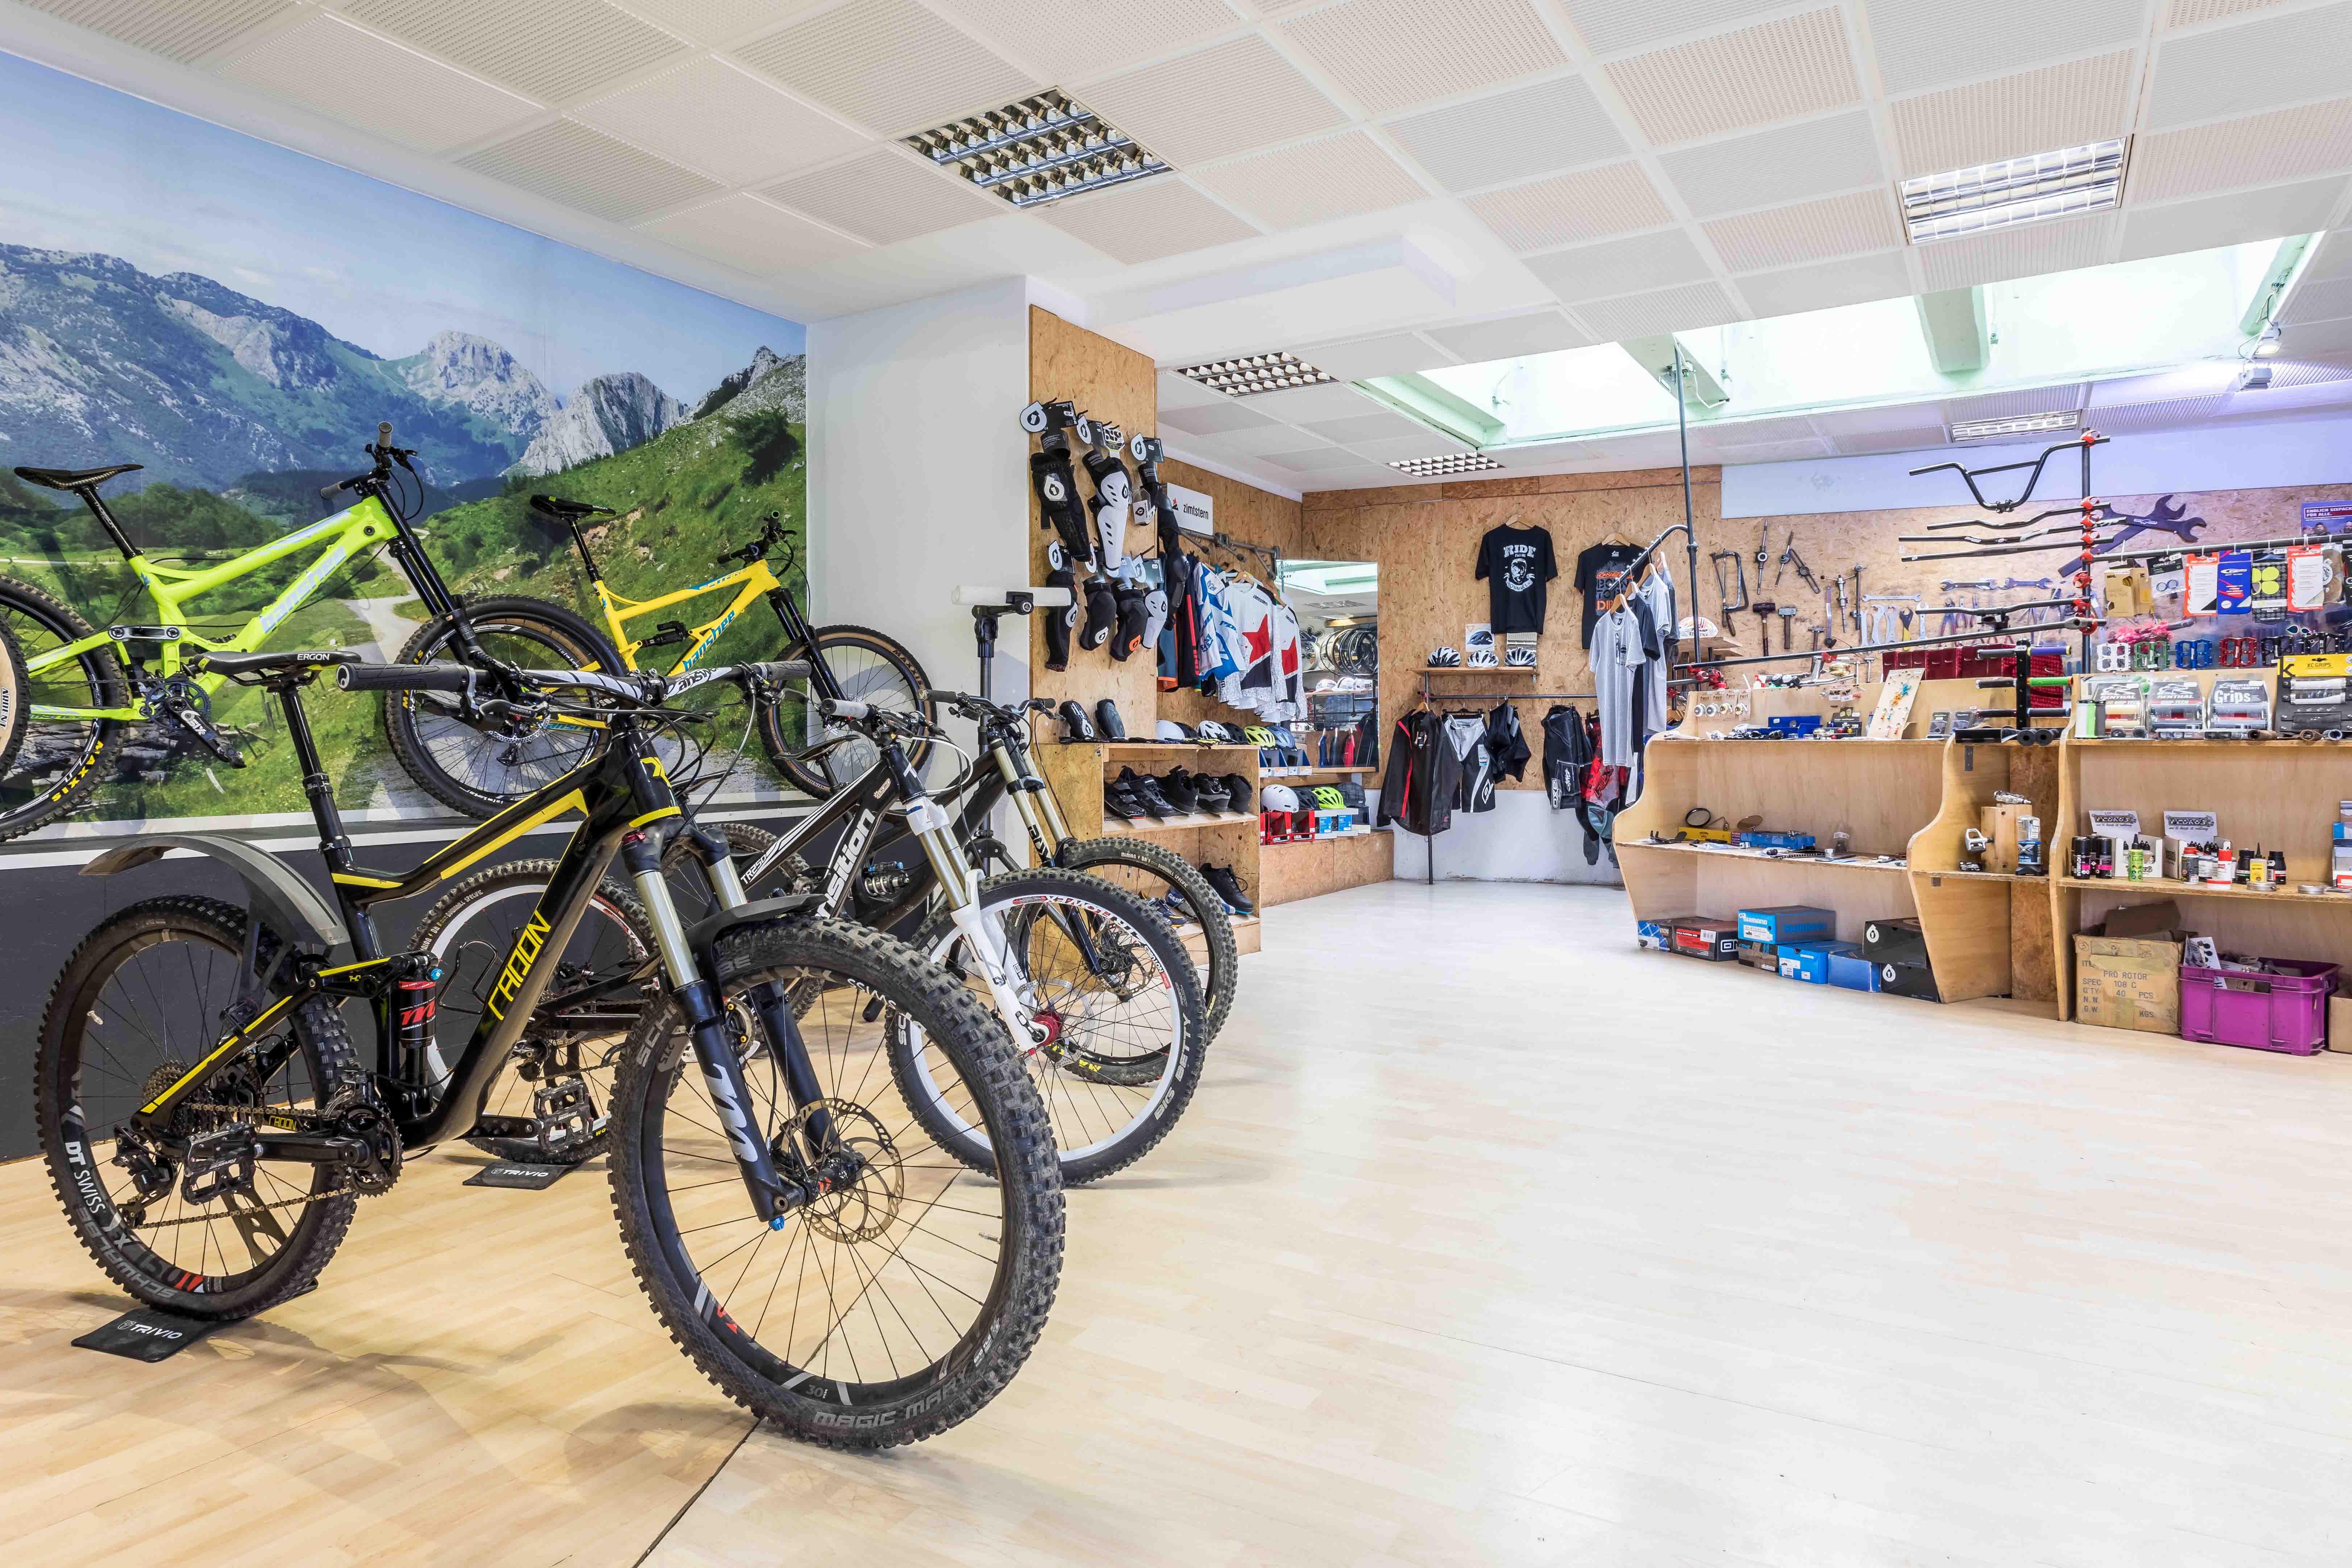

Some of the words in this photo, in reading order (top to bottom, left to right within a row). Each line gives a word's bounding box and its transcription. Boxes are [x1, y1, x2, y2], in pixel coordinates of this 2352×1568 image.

[1183, 503, 1209, 520] zimtstern
[1503, 544, 1536, 558] RIDE
[1253, 595, 1268, 606] zimtstern
[2214, 690, 2251, 704] Grips
[52, 740, 104, 802] MAXXIS
[1158, 863, 1174, 876] DOWNHILL
[1174, 874, 1189, 888] SPECIFIC
[1743, 917, 1768, 925] SHIMANO
[1144, 945, 1164, 973] NOTUBES
[847, 979, 897, 1009] SWISS
[1154, 1086, 1175, 1120] BIG
[1175, 1012, 1191, 1082] BETTY
[64, 1141, 86, 1166] DT
[74, 1169, 105, 1215] SWISS
[75, 1206, 181, 1299] SCHWALBE
[130, 1324, 183, 1339] TRIVIO
[814, 1411, 896, 1429] MAGIC
